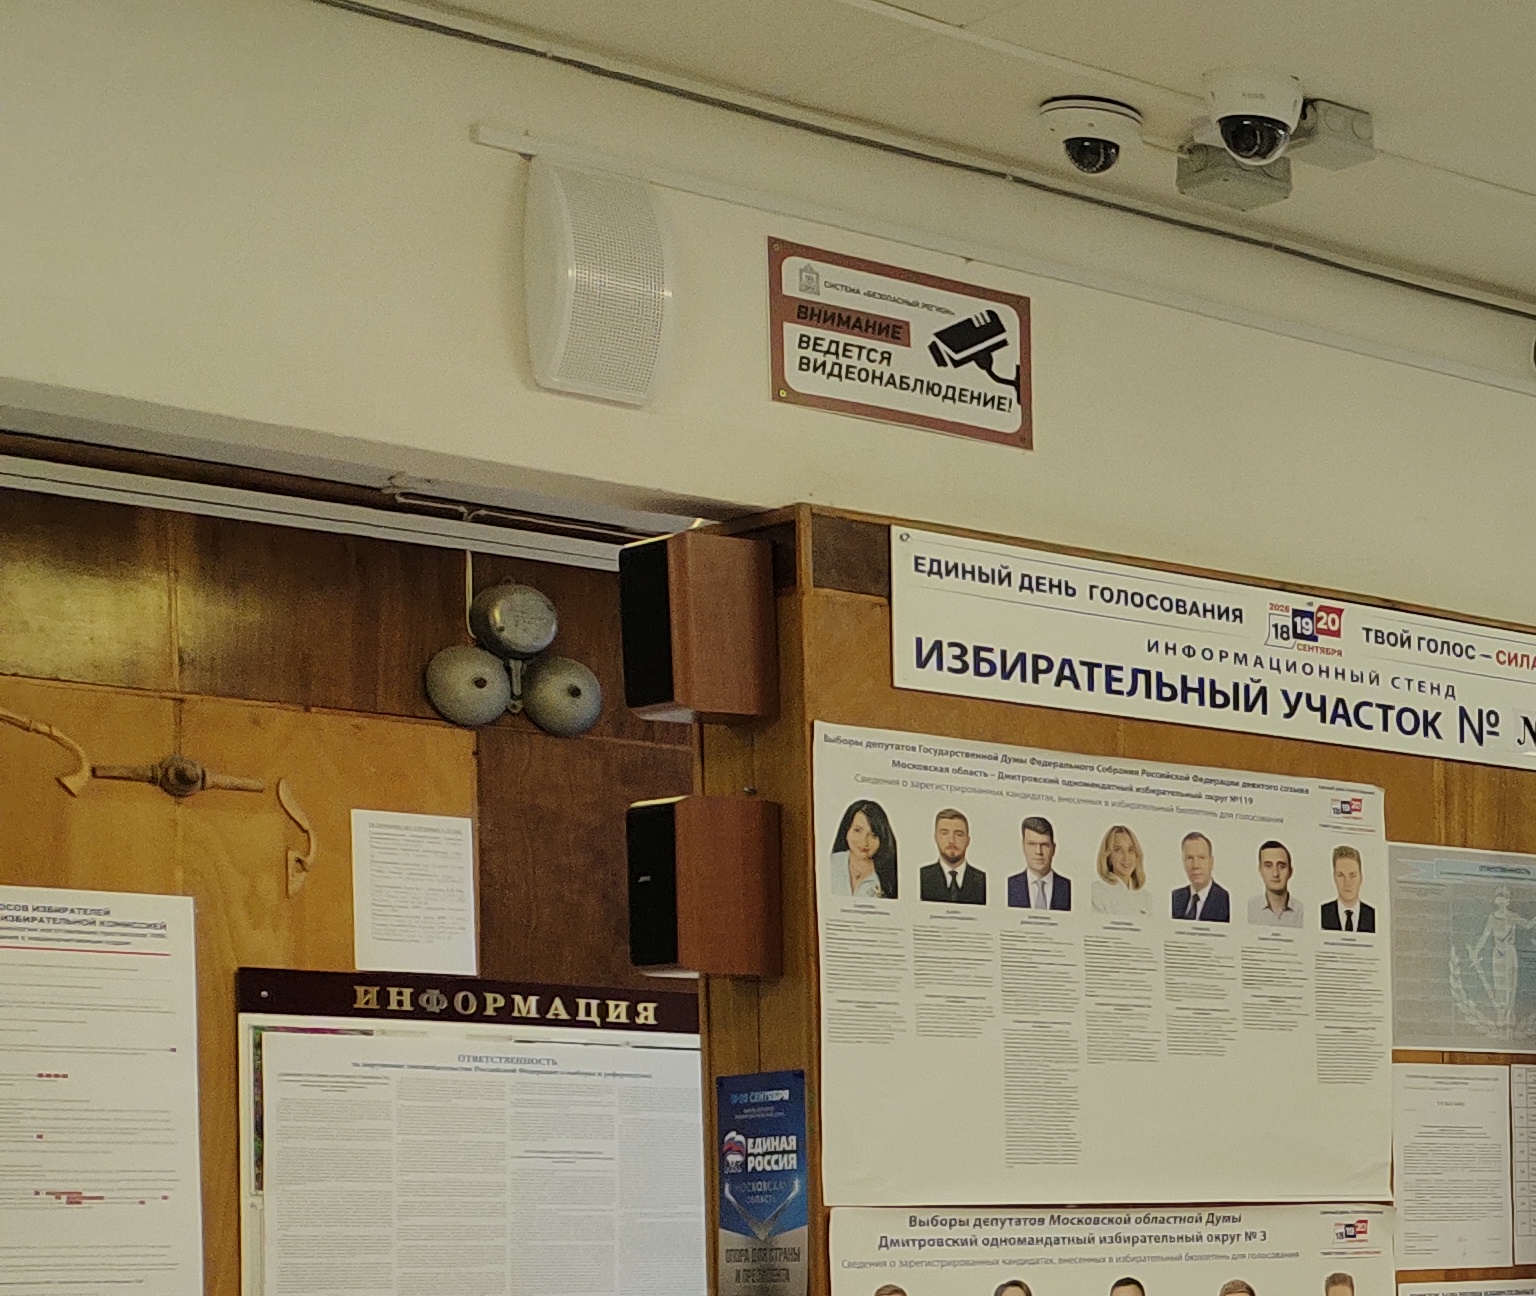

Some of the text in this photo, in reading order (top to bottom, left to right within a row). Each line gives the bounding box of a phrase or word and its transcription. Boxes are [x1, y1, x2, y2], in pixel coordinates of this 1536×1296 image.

[824, 281, 861, 295] СИСТЕМА
[796, 304, 904, 340] ВНИМАНИЕ
[798, 333, 892, 367] ВЕДЕТСЯ
[798, 356, 1013, 413] ВИДЕОНАБЛЮДЕНИЕ!
[913, 555, 1244, 624] ЕДИНЫЙ ДЕНЬ ГОЛОСОВАНИЯ
[1272, 612, 1339, 641] 18 19 20
[1297, 643, 1342, 657] СЕНТЯБРЯ
[1361, 626, 1412, 650] ТВОЙ
[1417, 636, 1476, 660] ГОЛОС
[1146, 638, 1457, 701] ИНФОРМАЦИОННЫЙ СТЕНД
[914, 636, 1268, 716] ИЗБИРАТЕЛЬНЫЙ
[1281, 688, 1444, 741] УЧАСТОК
[1458, 705, 1500, 747] №
[824, 733, 863, 748] Выборы
[865, 740, 917, 753] депутатов
[919, 744, 999, 762] Государственной
[1000, 753, 1027, 766] Думы
[1029, 756, 1095, 773] Федерального
[1096, 764, 1139, 777] Собрания
[1141, 769, 1190, 782] Российской
[1192, 775, 1240, 789] Федерации
[892, 759, 949, 774] Московская
[952, 766, 989, 778] область
[997, 771, 1059, 786] Дмитровский
[0, 915, 96, 927] ИЗБИРАТЕЛЬНОЙ
[32, 905, 111, 916] ИЗБИРАТЕЛЕЙ
[352, 984, 659, 1027] ИНФОРМАЦИЯ
[458, 1054, 558, 1066] ОТВЕТСТВЕННОСТЬ
[747, 1136, 797, 1154] ЕДИНАЯ
[747, 1153, 797, 1172] РОССИЯ
[908, 1212, 1242, 1230] Выборы депутатов Московской областной Думы
[878, 1229, 1267, 1250] Дмитровский одномандатный избирательный округ № 3
[841, 1258, 887, 1269] Сведения
[889, 1260, 896, 1268] о
[898, 1258, 1000, 1270] зарегистрированных
